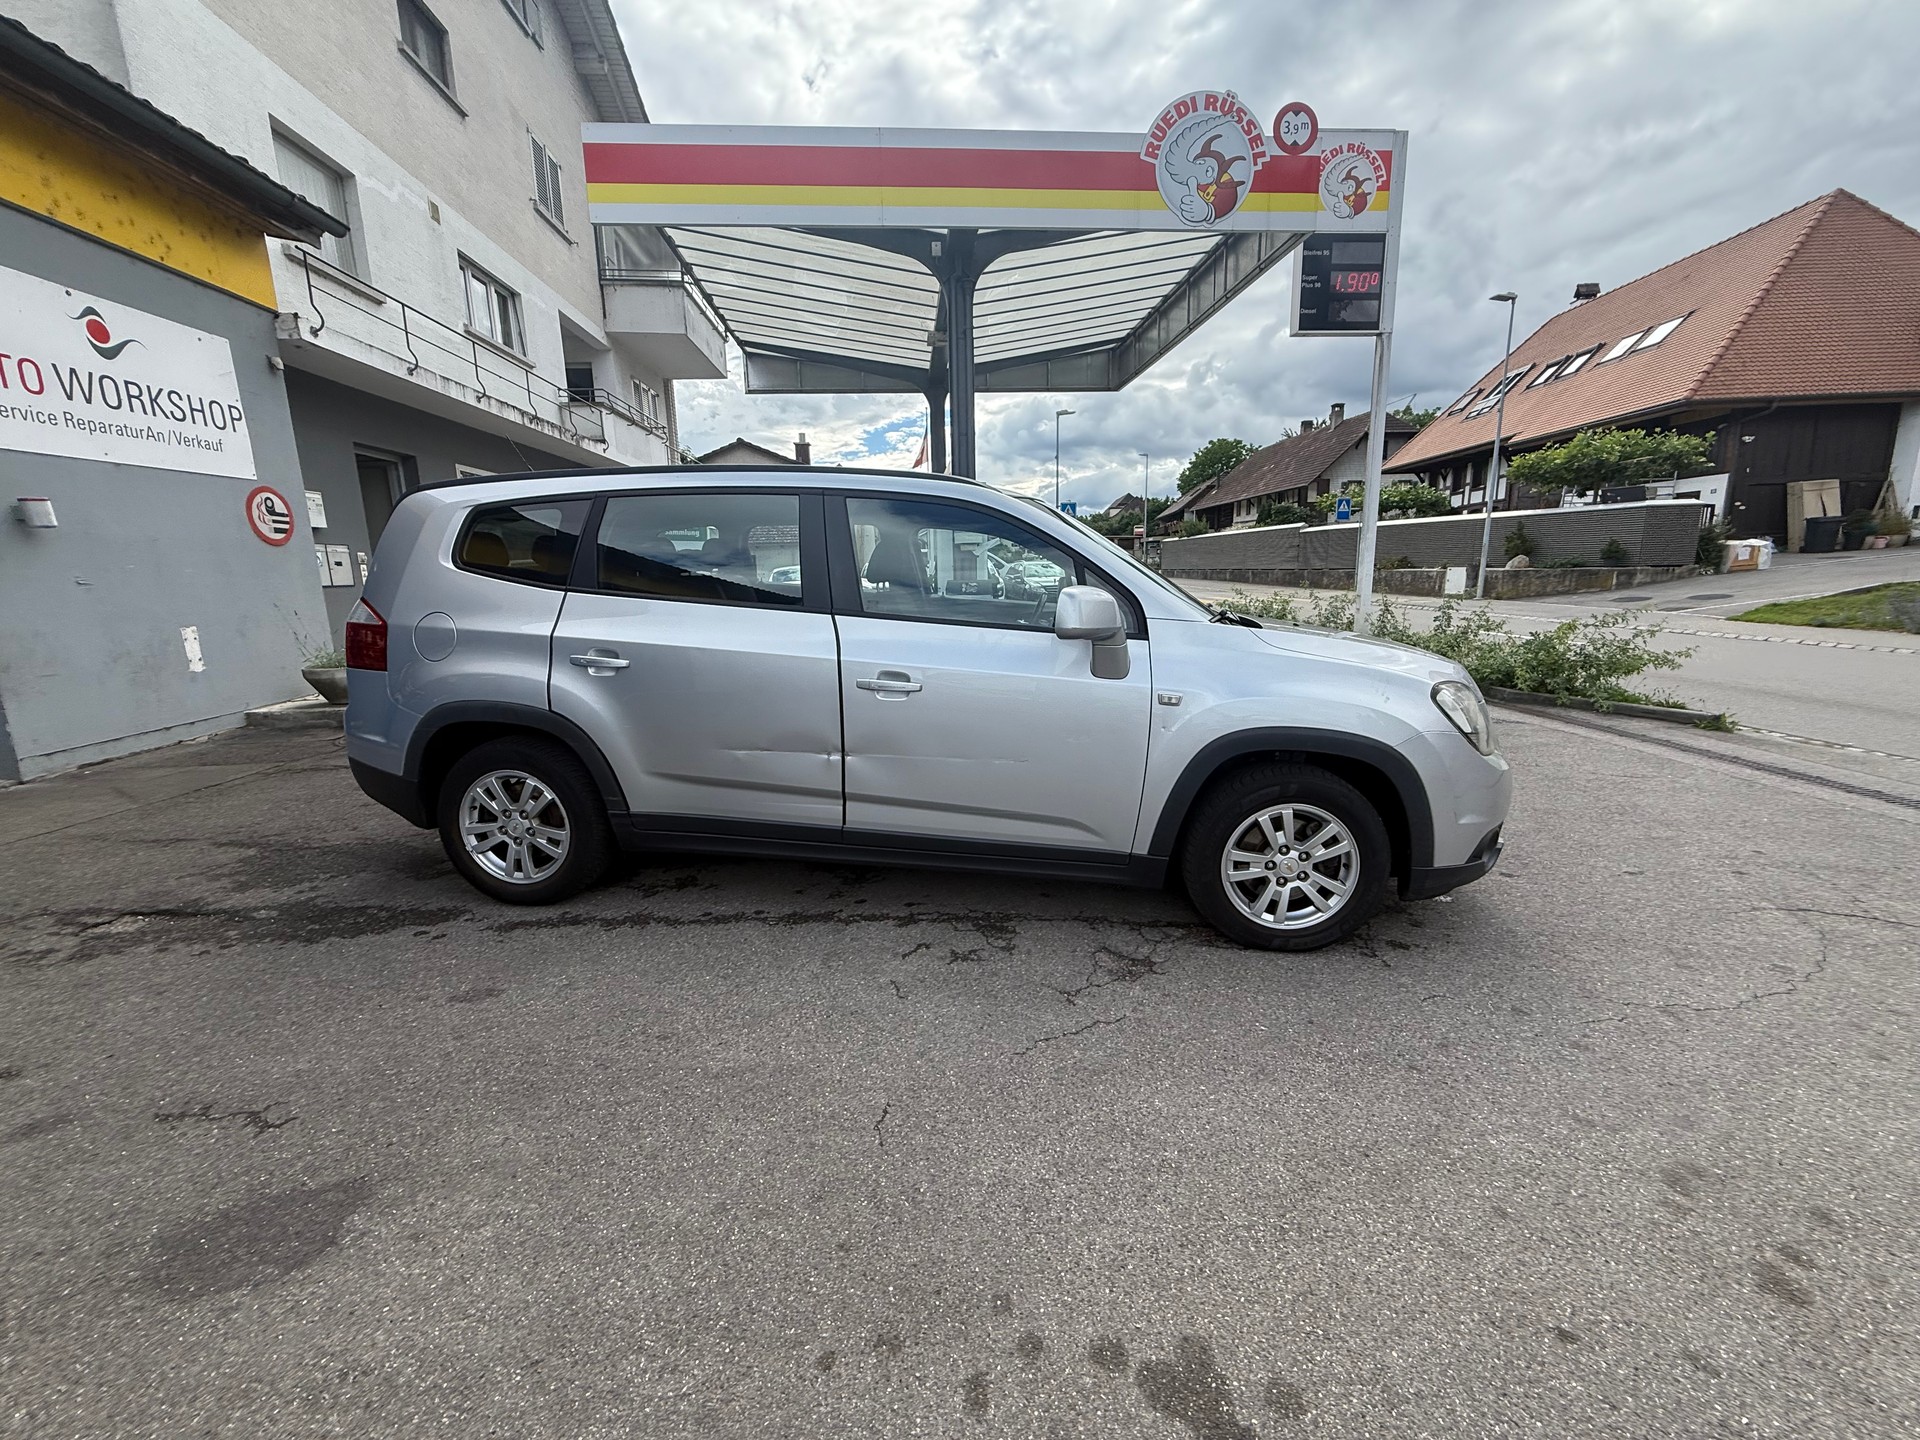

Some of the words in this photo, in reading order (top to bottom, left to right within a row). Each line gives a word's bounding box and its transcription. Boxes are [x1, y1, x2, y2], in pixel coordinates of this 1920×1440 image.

[1144, 96, 1198, 160] RUEDI
[1204, 92, 1266, 166] RÜSSEL
[1346, 141, 1385, 184] RÜSSEL
[51, 362, 242, 433] WORKSHOP
